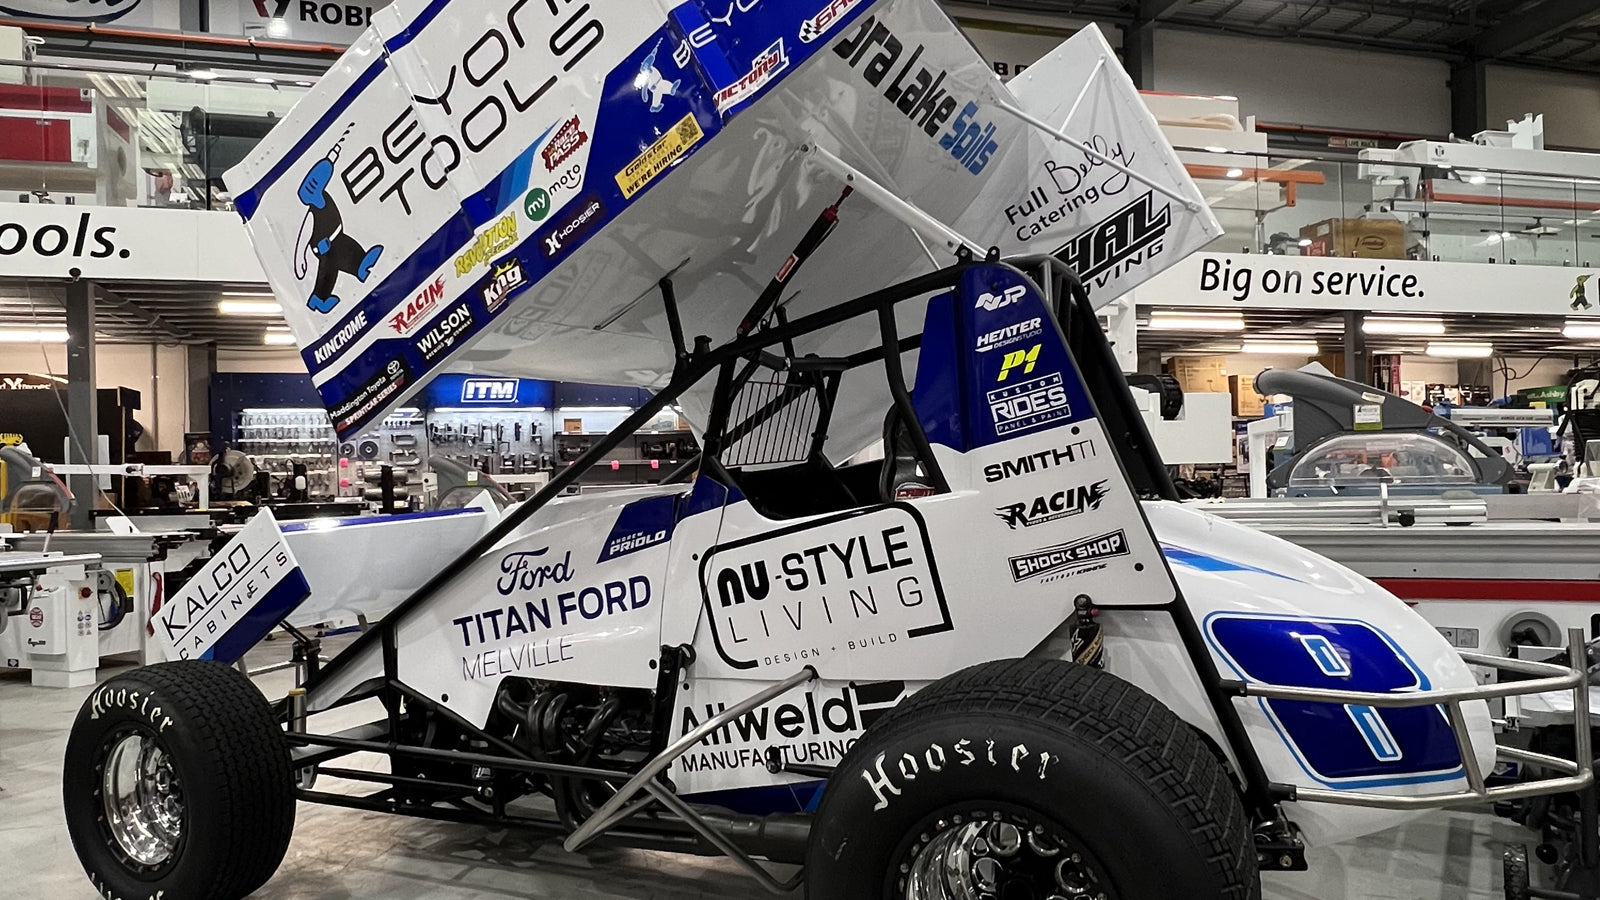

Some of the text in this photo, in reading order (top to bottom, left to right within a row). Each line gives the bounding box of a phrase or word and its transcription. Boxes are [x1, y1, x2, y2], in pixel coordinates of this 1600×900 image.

[380, 3, 604, 215] TOOLS
[884, 44, 957, 138] Lake
[938, 101, 998, 176] Soils
[549, 133, 580, 167] PASS
[626, 144, 683, 195] WE'RE HIRING
[549, 164, 581, 196] moto
[1004, 135, 1135, 226] Full Belly
[559, 200, 601, 240] HOOSIER
[1016, 186, 1100, 242] Catering
[1200, 258, 1425, 301] Big on service.
[314, 310, 368, 364] KINCROME
[417, 303, 471, 353] WILSON
[976, 317, 1041, 347] HEATER
[997, 344, 1042, 381] P1
[367, 375, 387, 395] Toyota
[378, 382, 397, 403] SERIES
[466, 381, 513, 399] ITM
[990, 376, 1060, 400] KUSTOM
[990, 387, 1068, 422] RIDES
[998, 419, 1027, 433] PANEL
[1041, 408, 1069, 420] PAINT
[611, 531, 644, 545] ANDREW
[1016, 549, 1074, 576] SHOCK
[1075, 535, 1121, 559] SHOP
[162, 543, 250, 640] KALCO
[496, 546, 575, 596] Ford
[179, 552, 288, 661] CABINETS
[453, 575, 651, 647] TITAN FORD
[728, 576, 923, 643] LIVING
[462, 638, 574, 681] MELVILLE
[764, 648, 820, 666] DESIGN
[848, 633, 897, 650] BUILD
[91, 686, 174, 732] Hoosier
[861, 738, 1060, 811] Hoosier
